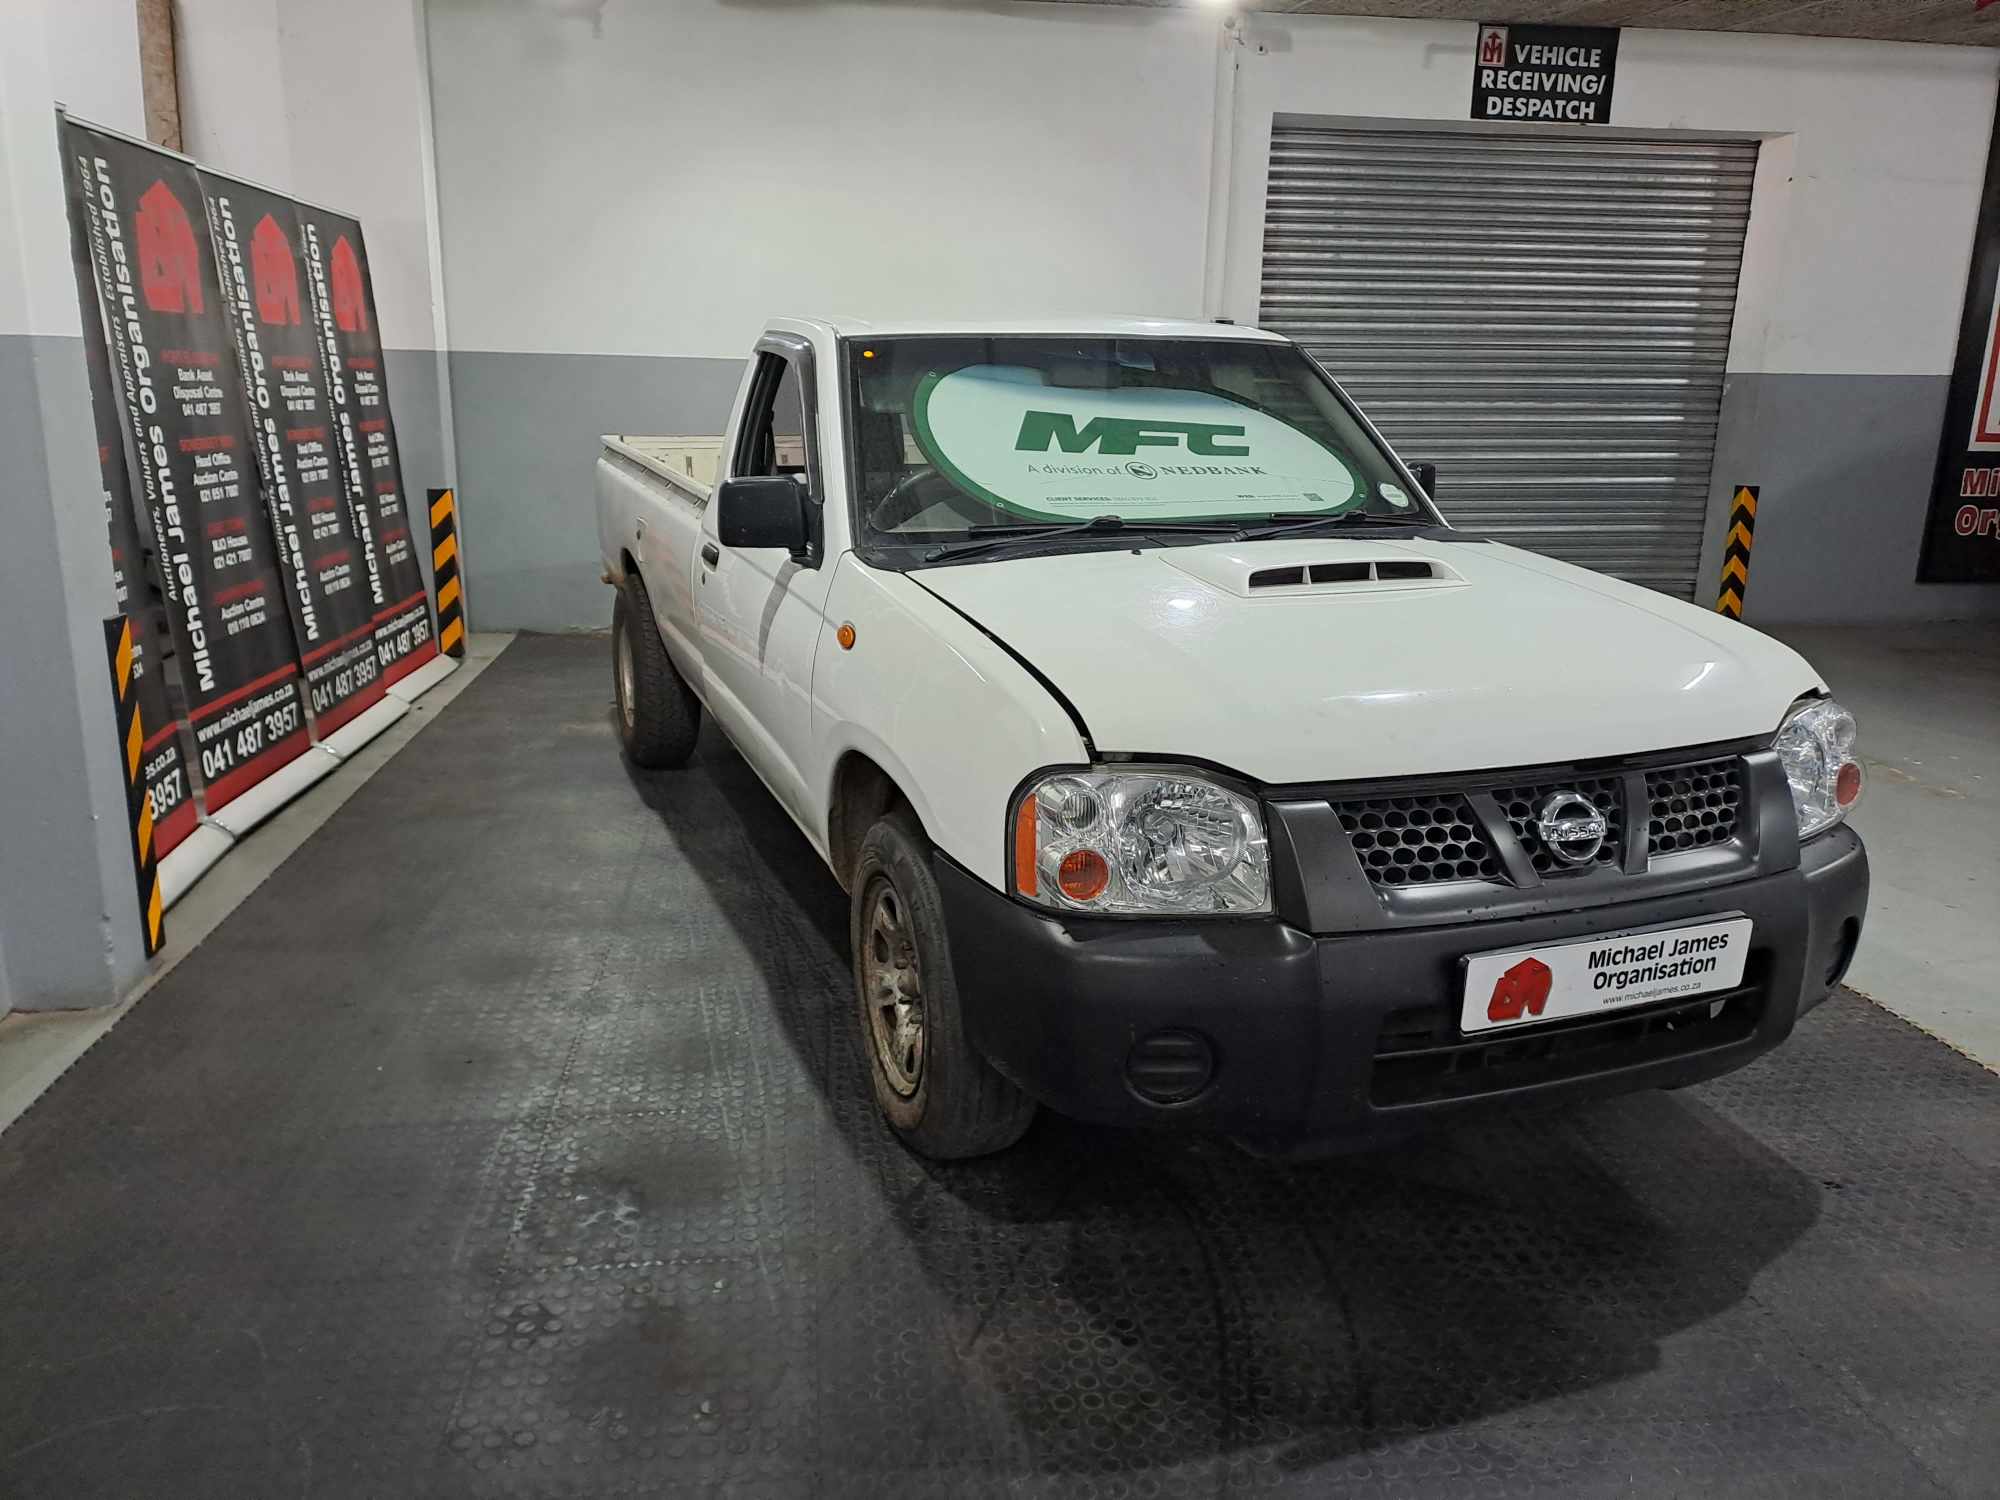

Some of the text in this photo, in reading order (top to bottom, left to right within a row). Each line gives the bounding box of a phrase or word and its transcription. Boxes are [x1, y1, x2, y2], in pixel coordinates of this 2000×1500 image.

[1514, 44, 1602, 68] VEHICLE
[1481, 69, 1607, 95] RECEIVING/
[1486, 96, 1596, 120] DESPATCH
[78, 155, 94, 198] 1964
[87, 202, 115, 301] Established
[218, 197, 270, 409] Organisation
[307, 223, 345, 405] Organisation
[111, 315, 136, 402] Appraisers
[94, 157, 215, 692] Michael James Organisation
[129, 405, 143, 437] and
[1014, 410, 1251, 457] MFC
[138, 442, 157, 500] Valuers
[264, 418, 293, 516] James
[340, 412, 363, 497] James
[1027, 463, 1268, 477] A division of NEDBANK
[1960, 467, 2000, 497] Mi
[1955, 504, 2000, 540] Or
[355, 503, 384, 605] Michael
[283, 524, 319, 641] Michael
[377, 641, 397, 667] 041
[396, 630, 411, 656] 487
[311, 655, 377, 713] 041 487 3957
[202, 701, 299, 780] 041 487 3957
[1587, 933, 1729, 970] Michael James
[1593, 954, 1717, 991] Organisation
[1602, 981, 1702, 1005] www.michaeljames.co.za
